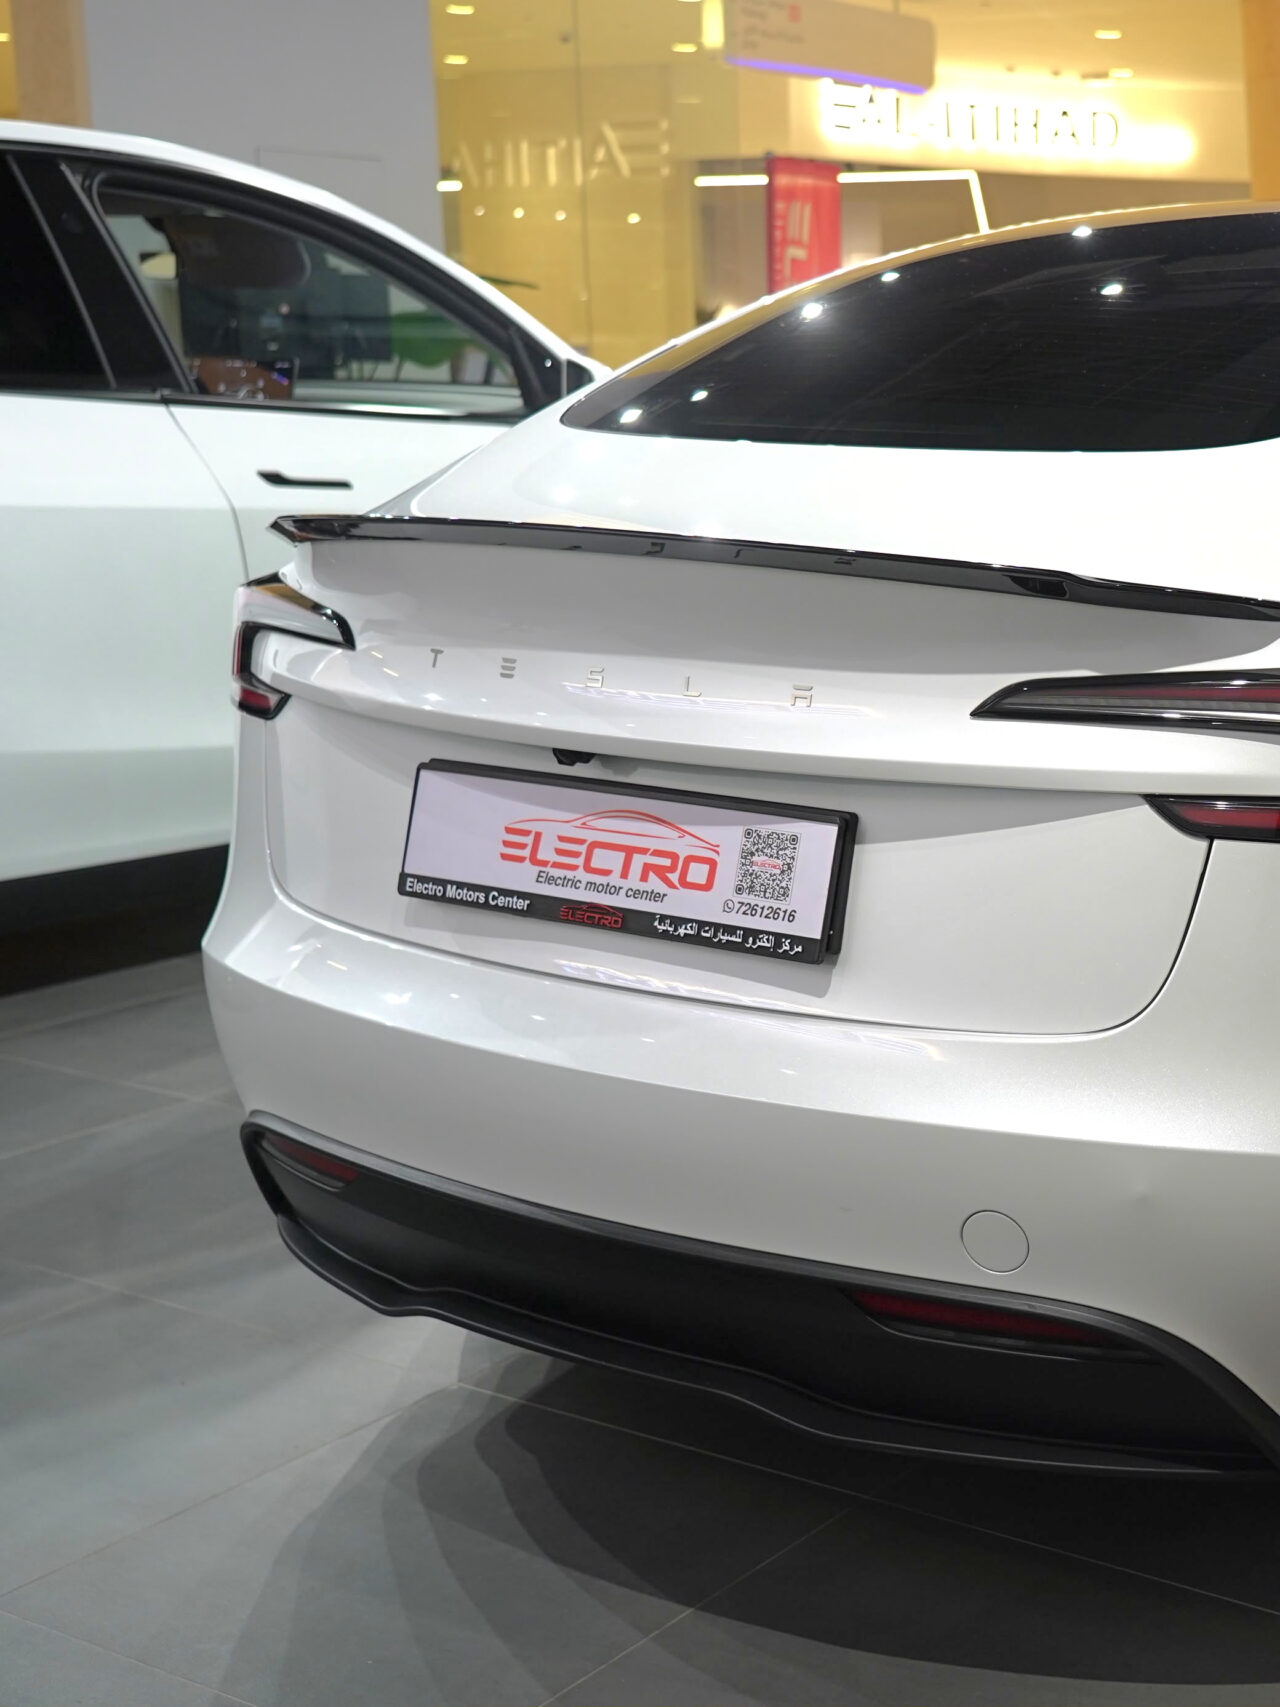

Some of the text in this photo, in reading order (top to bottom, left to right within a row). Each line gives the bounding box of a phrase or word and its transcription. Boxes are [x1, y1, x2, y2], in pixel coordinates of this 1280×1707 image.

[430, 647, 814, 707] TESLA
[500, 826, 718, 893] ELECTRO
[406, 877, 530, 911] Electro Motors Center
[536, 870, 667, 903] Electric motor center
[560, 908, 623, 929] ELECTRO
[735, 901, 797, 923] 72612616
[701, 926, 743, 943] للسيارات
[777, 938, 803, 955] مركز
